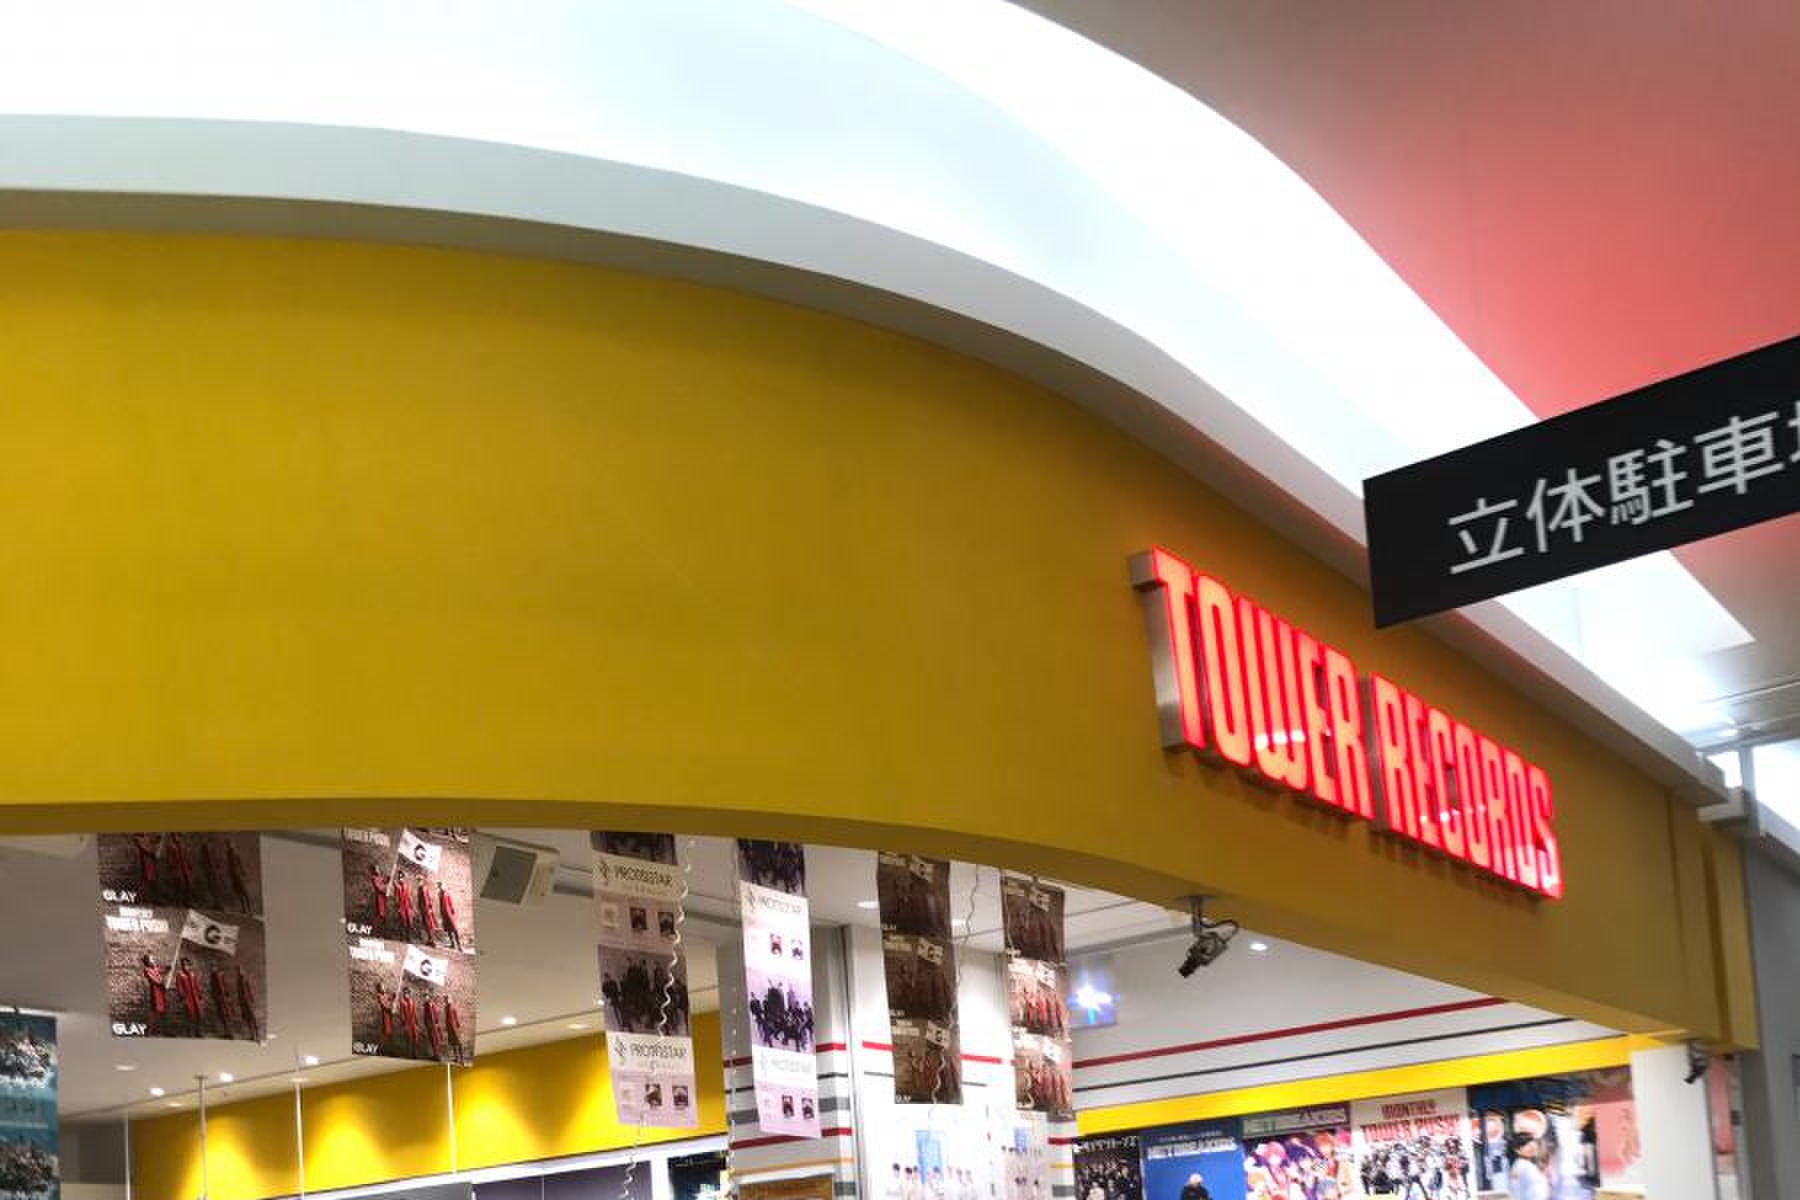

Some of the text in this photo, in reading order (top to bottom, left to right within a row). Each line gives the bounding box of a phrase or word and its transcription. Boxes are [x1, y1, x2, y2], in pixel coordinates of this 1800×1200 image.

[1447, 399, 1800, 574] 立体駐車
[1152, 545, 1565, 900] TOWER RECORDS
[102, 889, 137, 903] GLAY
[347, 922, 373, 935] GLAY
[112, 1022, 147, 1036] GLAY
